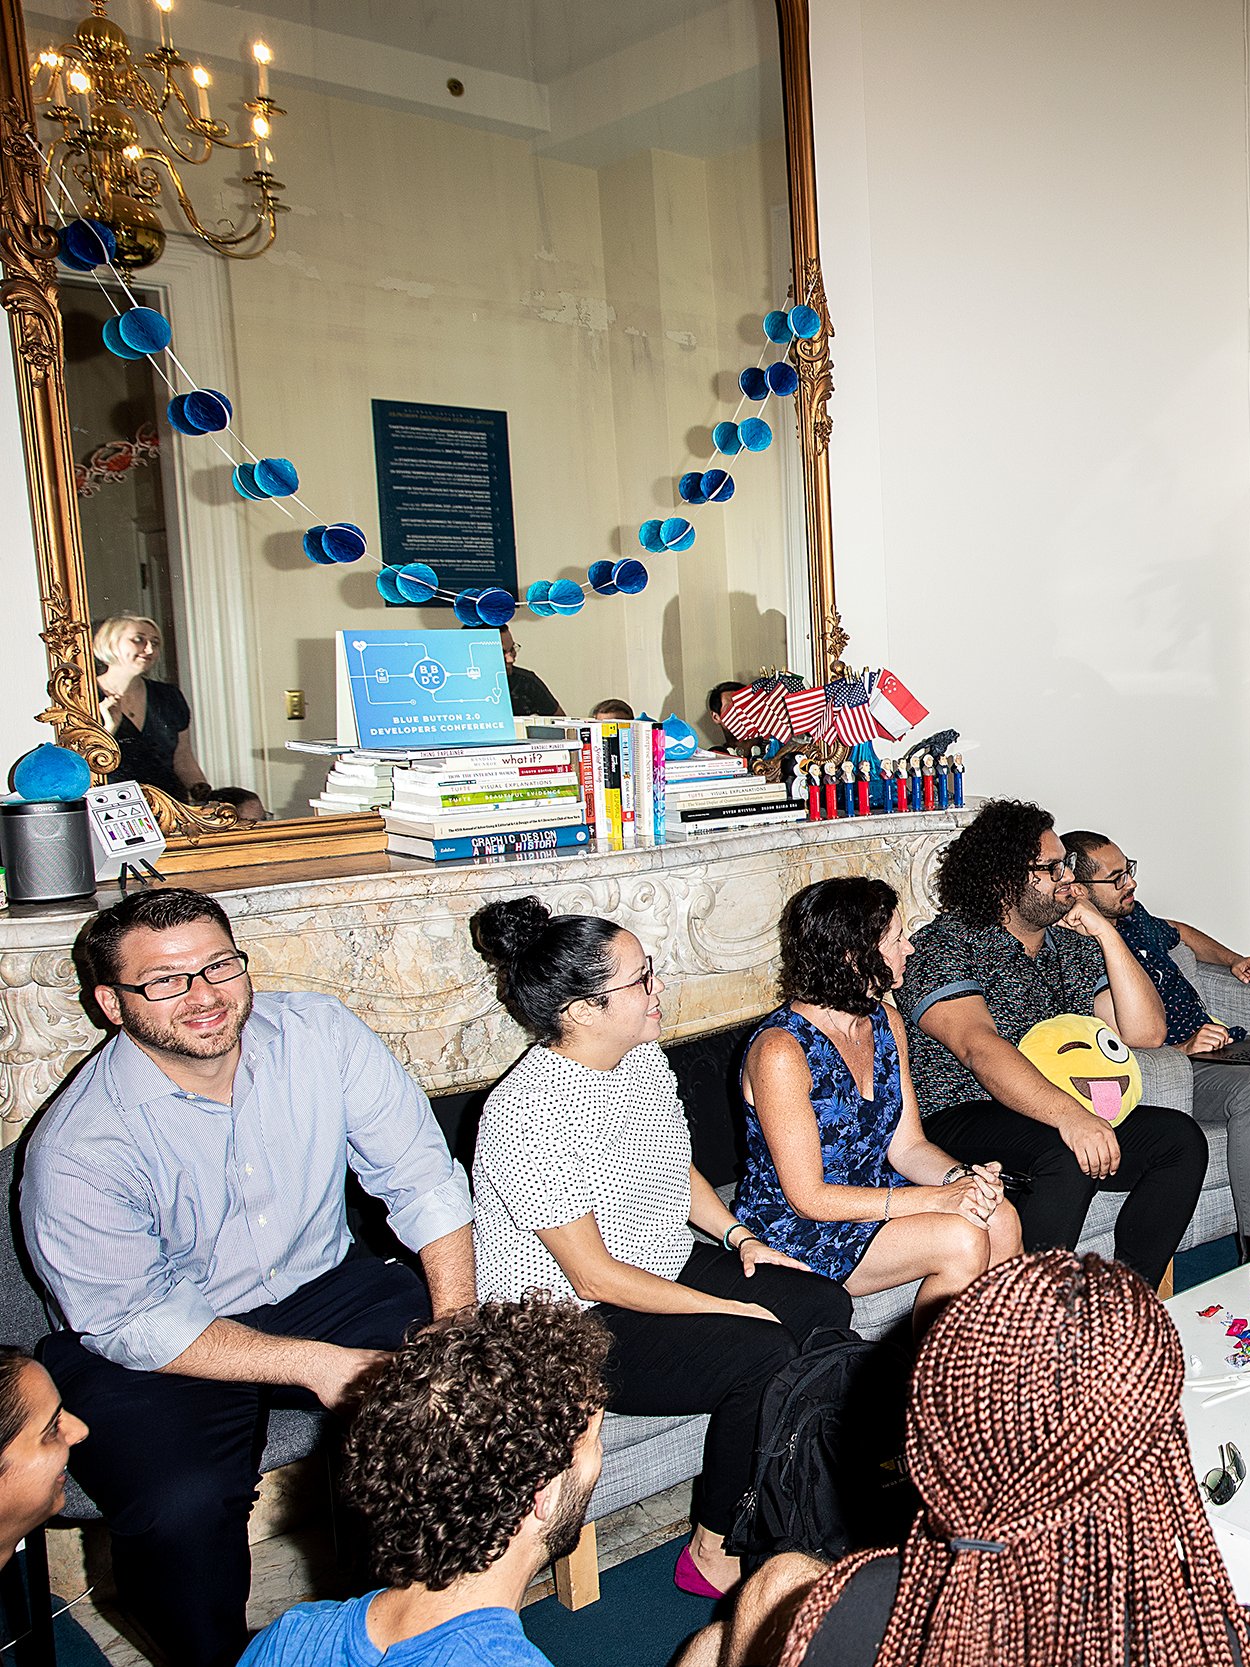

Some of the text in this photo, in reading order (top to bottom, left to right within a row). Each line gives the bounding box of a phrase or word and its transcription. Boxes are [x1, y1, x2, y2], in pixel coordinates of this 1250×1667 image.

[393, 716, 419, 724] BLUE
[423, 714, 462, 723] BUTTON
[370, 721, 504, 735] DEVELOPERS CONFERENCE
[644, 729, 652, 759] Enterprise
[502, 753, 542, 764] what if?
[583, 749, 592, 769] WHITE
[480, 782, 502, 790] VISUAL
[505, 780, 552, 788] EXPLANATIONS
[584, 771, 593, 792] HOUSE
[484, 792, 523, 800] BEAUTIFUL
[471, 830, 556, 847] GRAPHIC DESIGN
[472, 840, 557, 856] A NEW HISTORY
